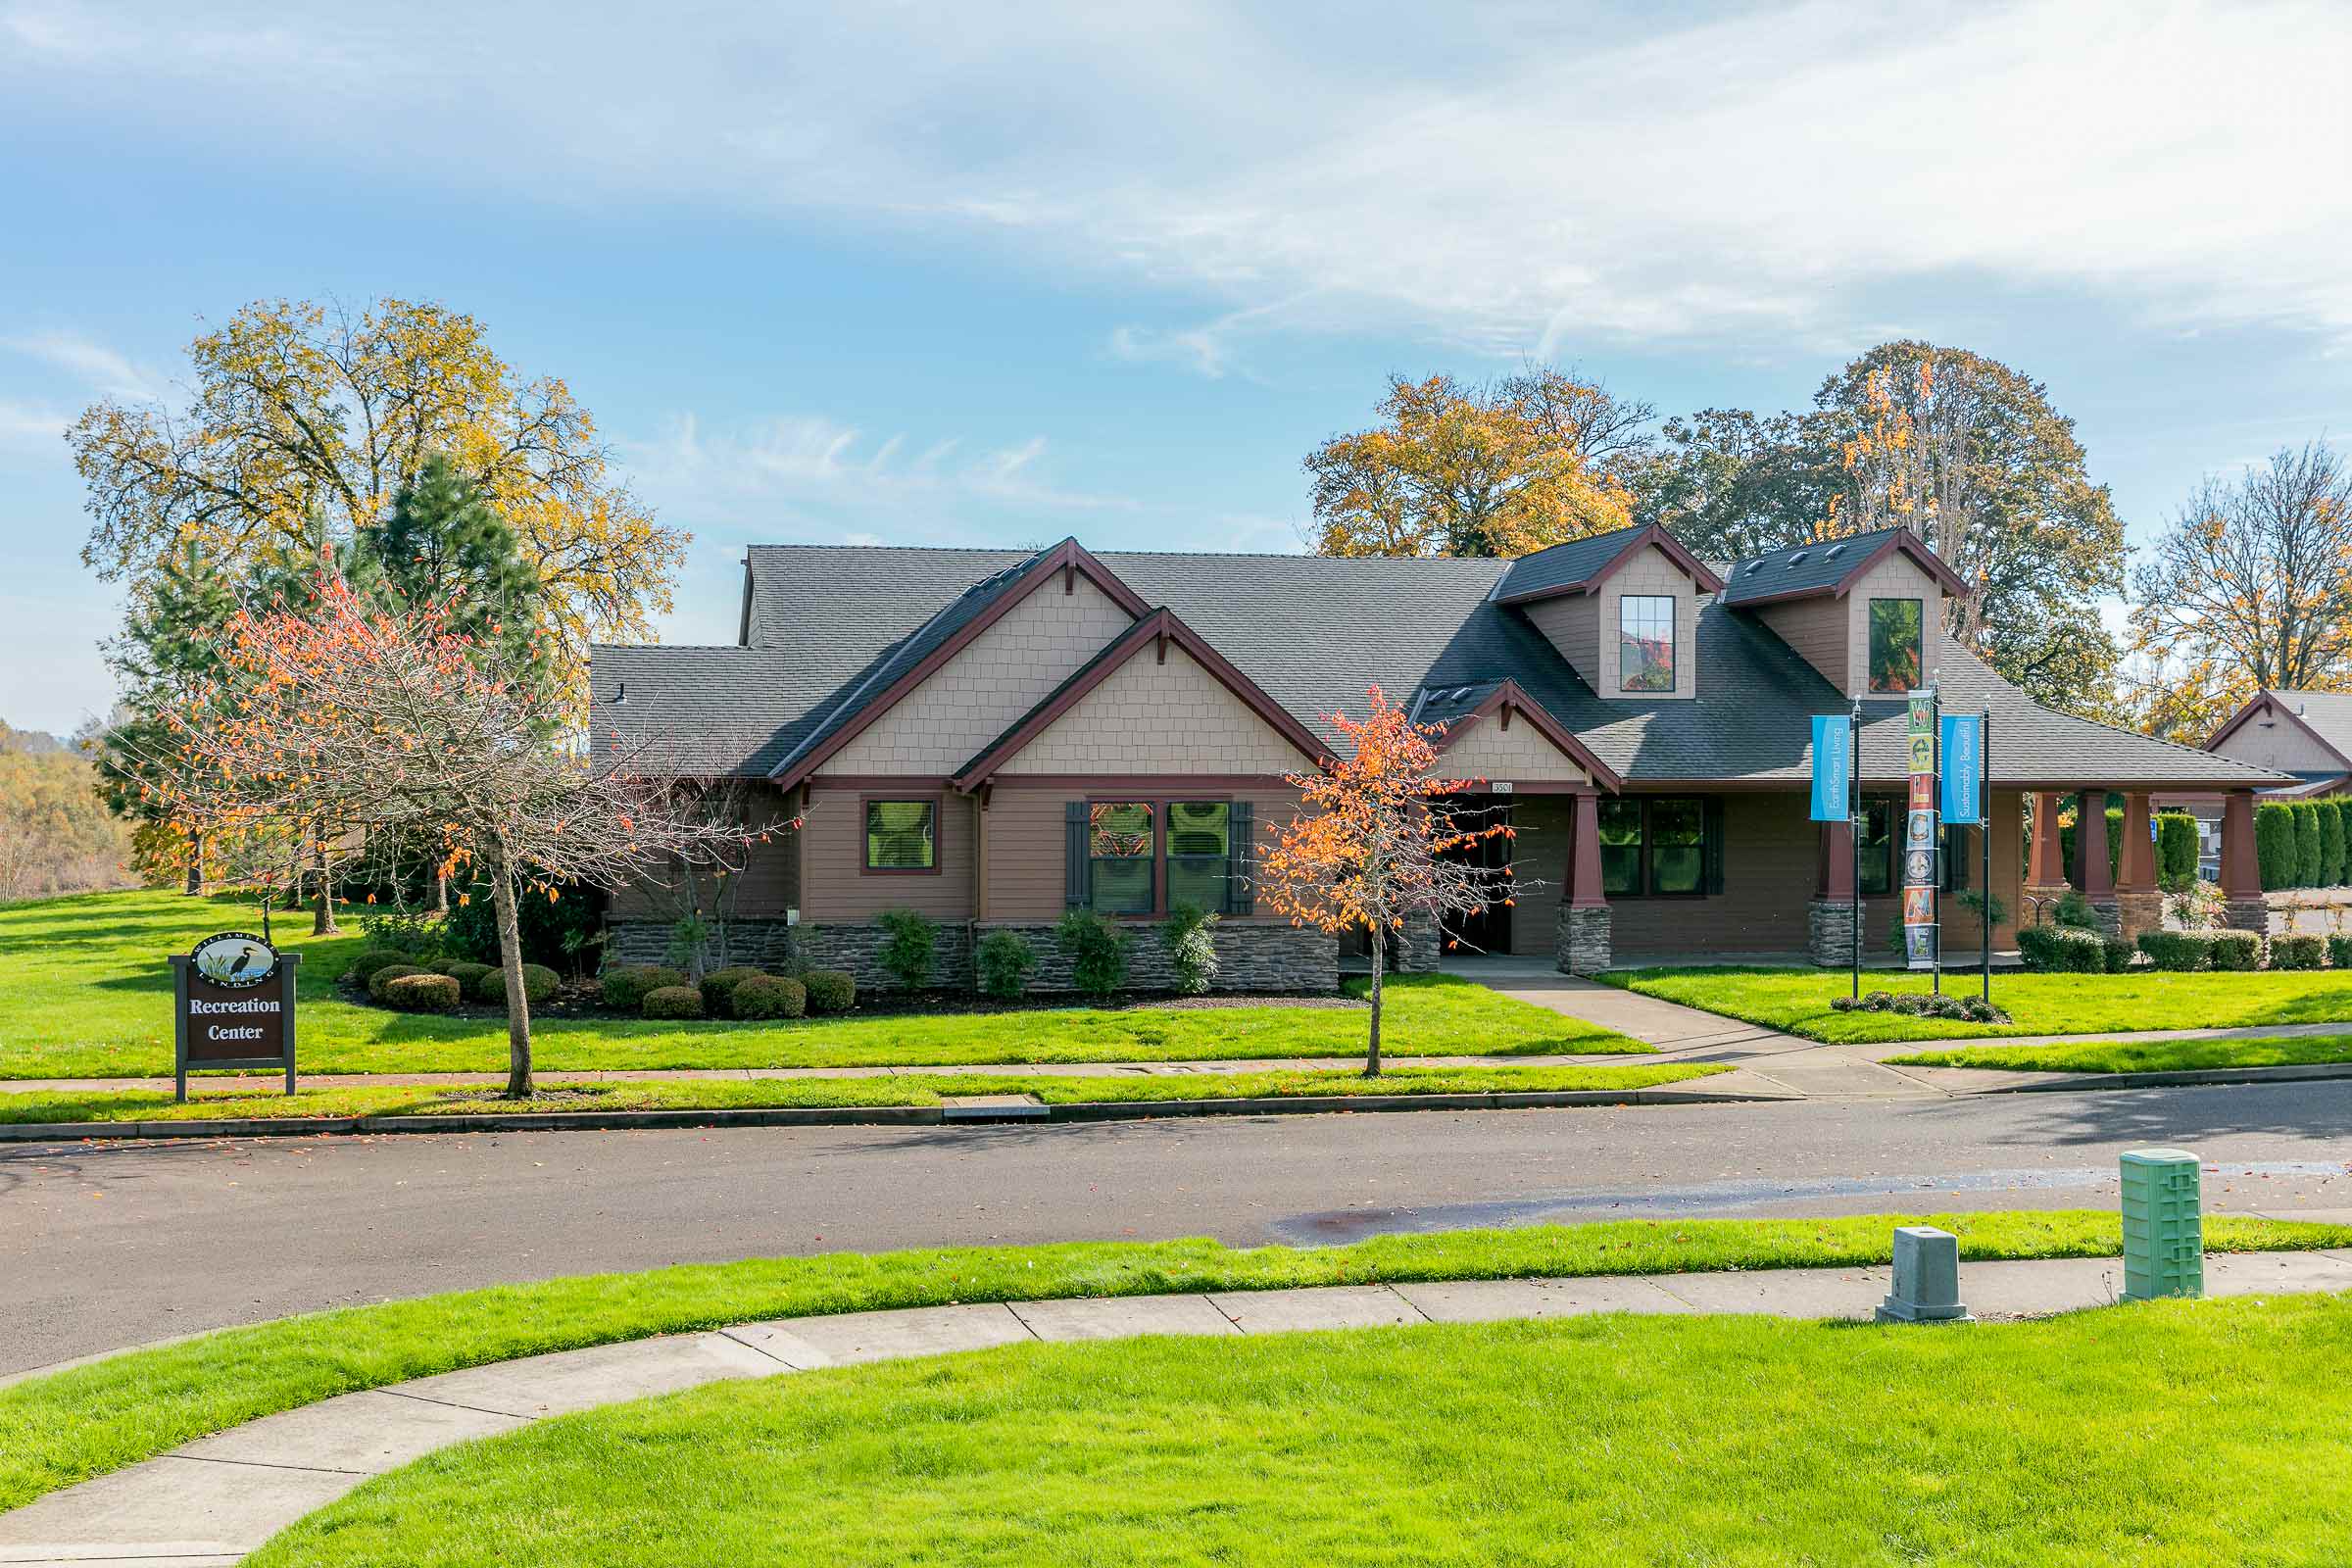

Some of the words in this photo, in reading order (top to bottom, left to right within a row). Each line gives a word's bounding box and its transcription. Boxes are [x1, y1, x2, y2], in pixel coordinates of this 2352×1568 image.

[1830, 727, 1843, 755] Living
[1960, 720, 1971, 761] Beautiful
[1493, 783, 1511, 792] 3501
[1828, 757, 1841, 808] EarthSmart
[1960, 764, 1973, 816] Sustainably
[194, 933, 275, 953] WILLAMETTE
[199, 971, 273, 988] LANDING
[189, 998, 281, 1013] Recreation
[208, 1025, 264, 1040] Center
